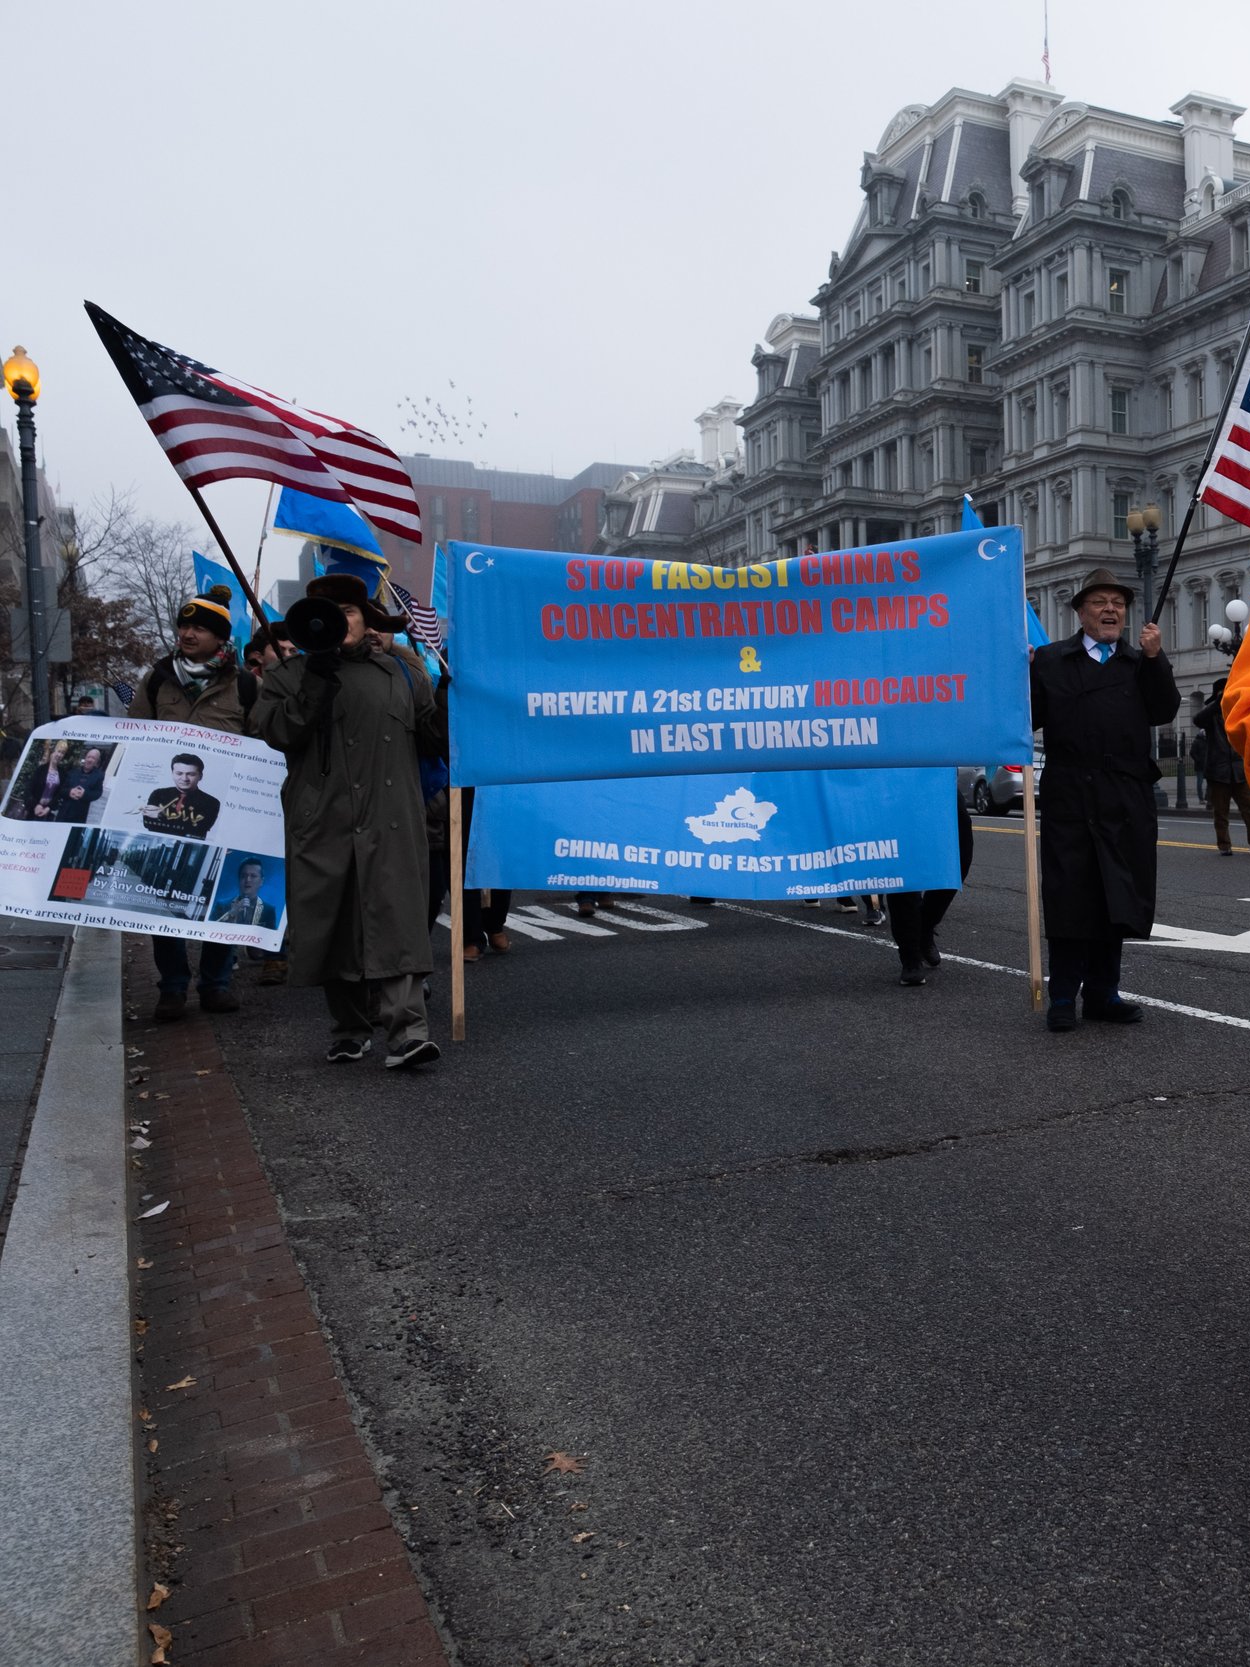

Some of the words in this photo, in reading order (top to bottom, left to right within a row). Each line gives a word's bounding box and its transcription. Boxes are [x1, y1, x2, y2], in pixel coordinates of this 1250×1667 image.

[566, 559, 644, 591] STOP
[652, 559, 793, 589] FASCIST
[542, 599, 822, 640] CONCENTRATION
[831, 593, 949, 633] CAMPS
[740, 646, 761, 672] &
[528, 691, 627, 715] PREVENT
[632, 691, 647, 712] A
[653, 690, 701, 712] 21st
[707, 685, 808, 710] CENTURY
[814, 674, 967, 706] HOLOCAUST
[153, 724, 179, 733] STOP
[632, 730, 654, 752] IN
[661, 723, 724, 752] EAST
[731, 718, 877, 749] TURKISTAN
[62, 730, 88, 739] Release
[103, 734, 130, 742] parents
[146, 736, 174, 744] brother
[176, 739, 196, 748] from
[198, 743, 211, 751] the
[212, 747, 267, 764] concentration
[233, 772, 243, 780] My
[246, 775, 265, 784] father
[225, 801, 236, 809] My
[238, 804, 262, 814] brother
[702, 819, 719, 827] East
[721, 820, 758, 830] Turkistan
[19, 851, 47, 860] PEACE
[554, 839, 619, 861] CHINA
[625, 846, 660, 864] GET
[665, 851, 704, 867] OUT
[709, 854, 731, 869] OF
[737, 856, 783, 872] EAST
[787, 839, 899, 871] TURKISTAN!
[96, 865, 105, 875] A
[107, 868, 128, 878] Jail
[93, 878, 107, 889] by
[110, 881, 132, 893] Any
[135, 884, 170, 898] Other
[171, 890, 207, 904] Name
[548, 874, 659, 890] #FreetheUyghurs
[786, 877, 903, 897] #SaveEastTurkistan
[5, 905, 33, 915] were
[35, 909, 81, 921] arrested
[83, 913, 106, 925] just
[109, 916, 156, 932] because
[158, 925, 184, 936] they
[186, 930, 206, 938] are
[209, 931, 263, 944] UYGHURS
